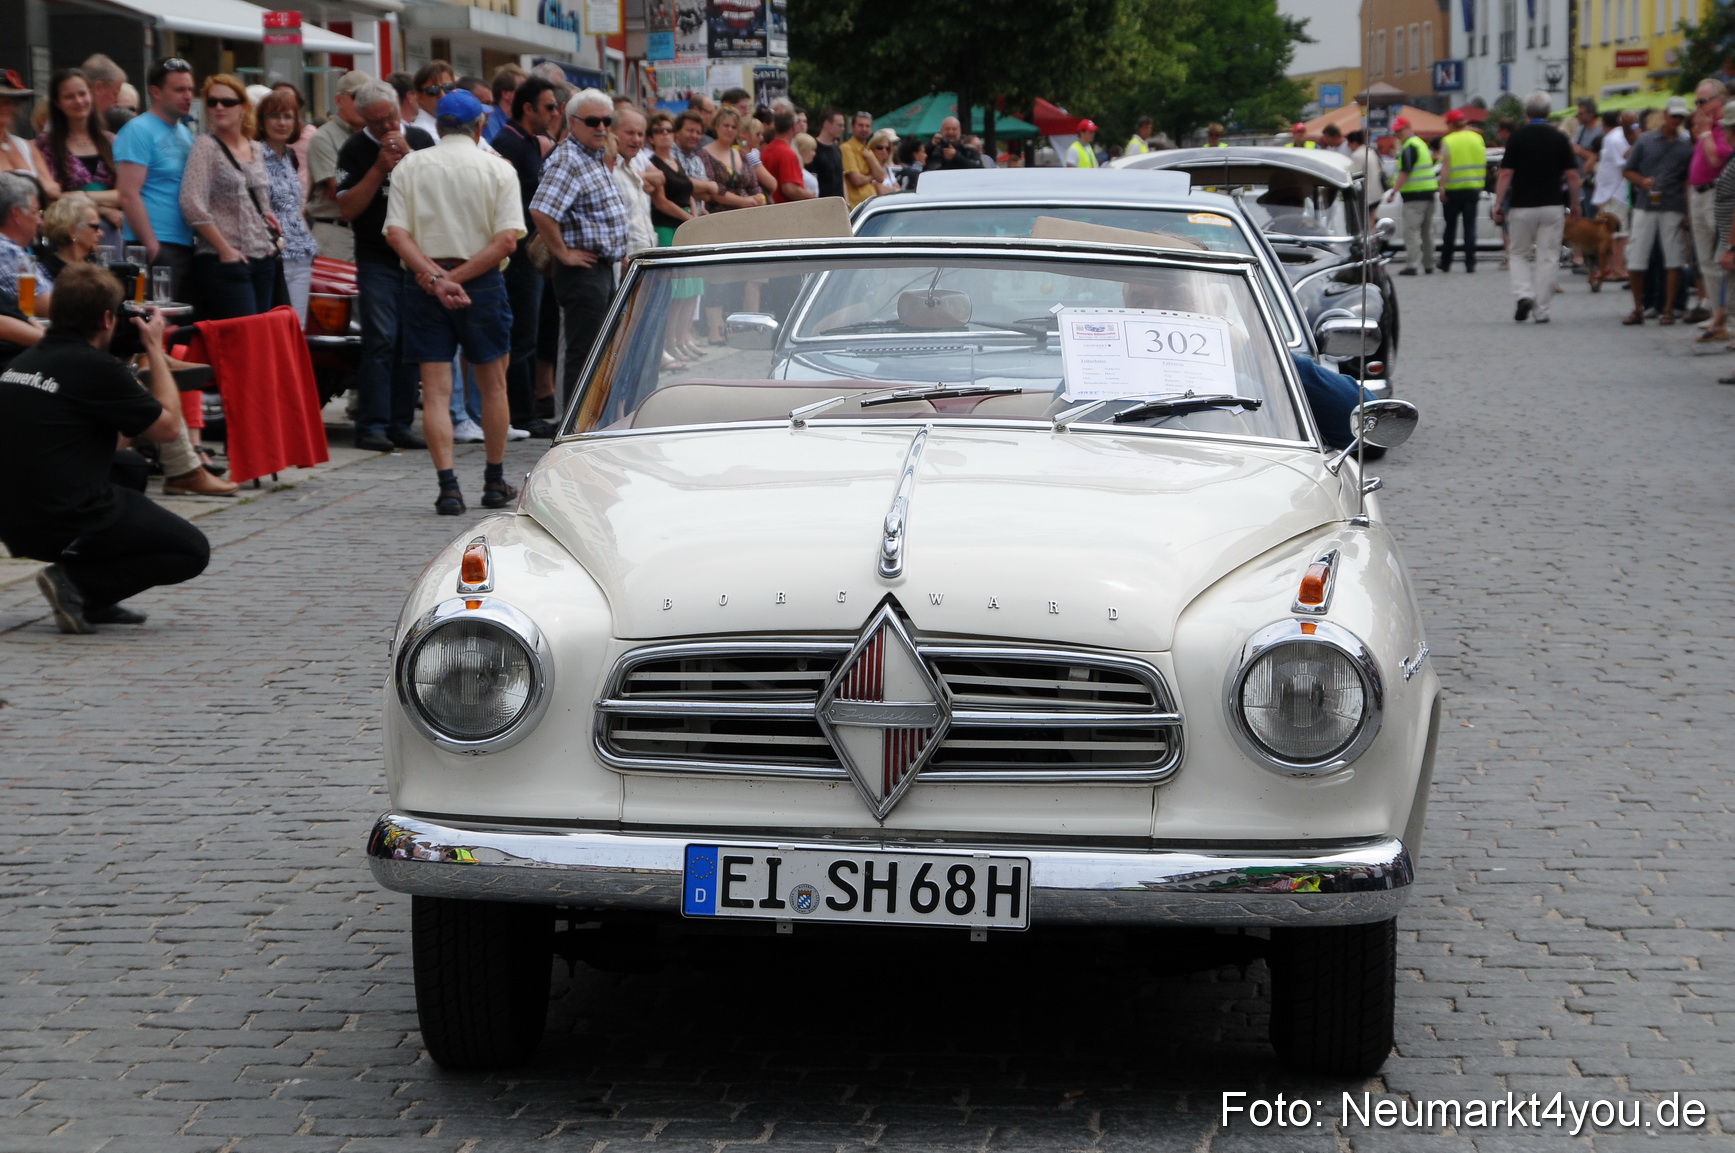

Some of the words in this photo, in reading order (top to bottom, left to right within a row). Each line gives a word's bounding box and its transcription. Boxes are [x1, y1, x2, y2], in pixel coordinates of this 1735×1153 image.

[1144, 330, 1211, 357] 302
[694, 888, 707, 903] D
[721, 855, 786, 909] EI
